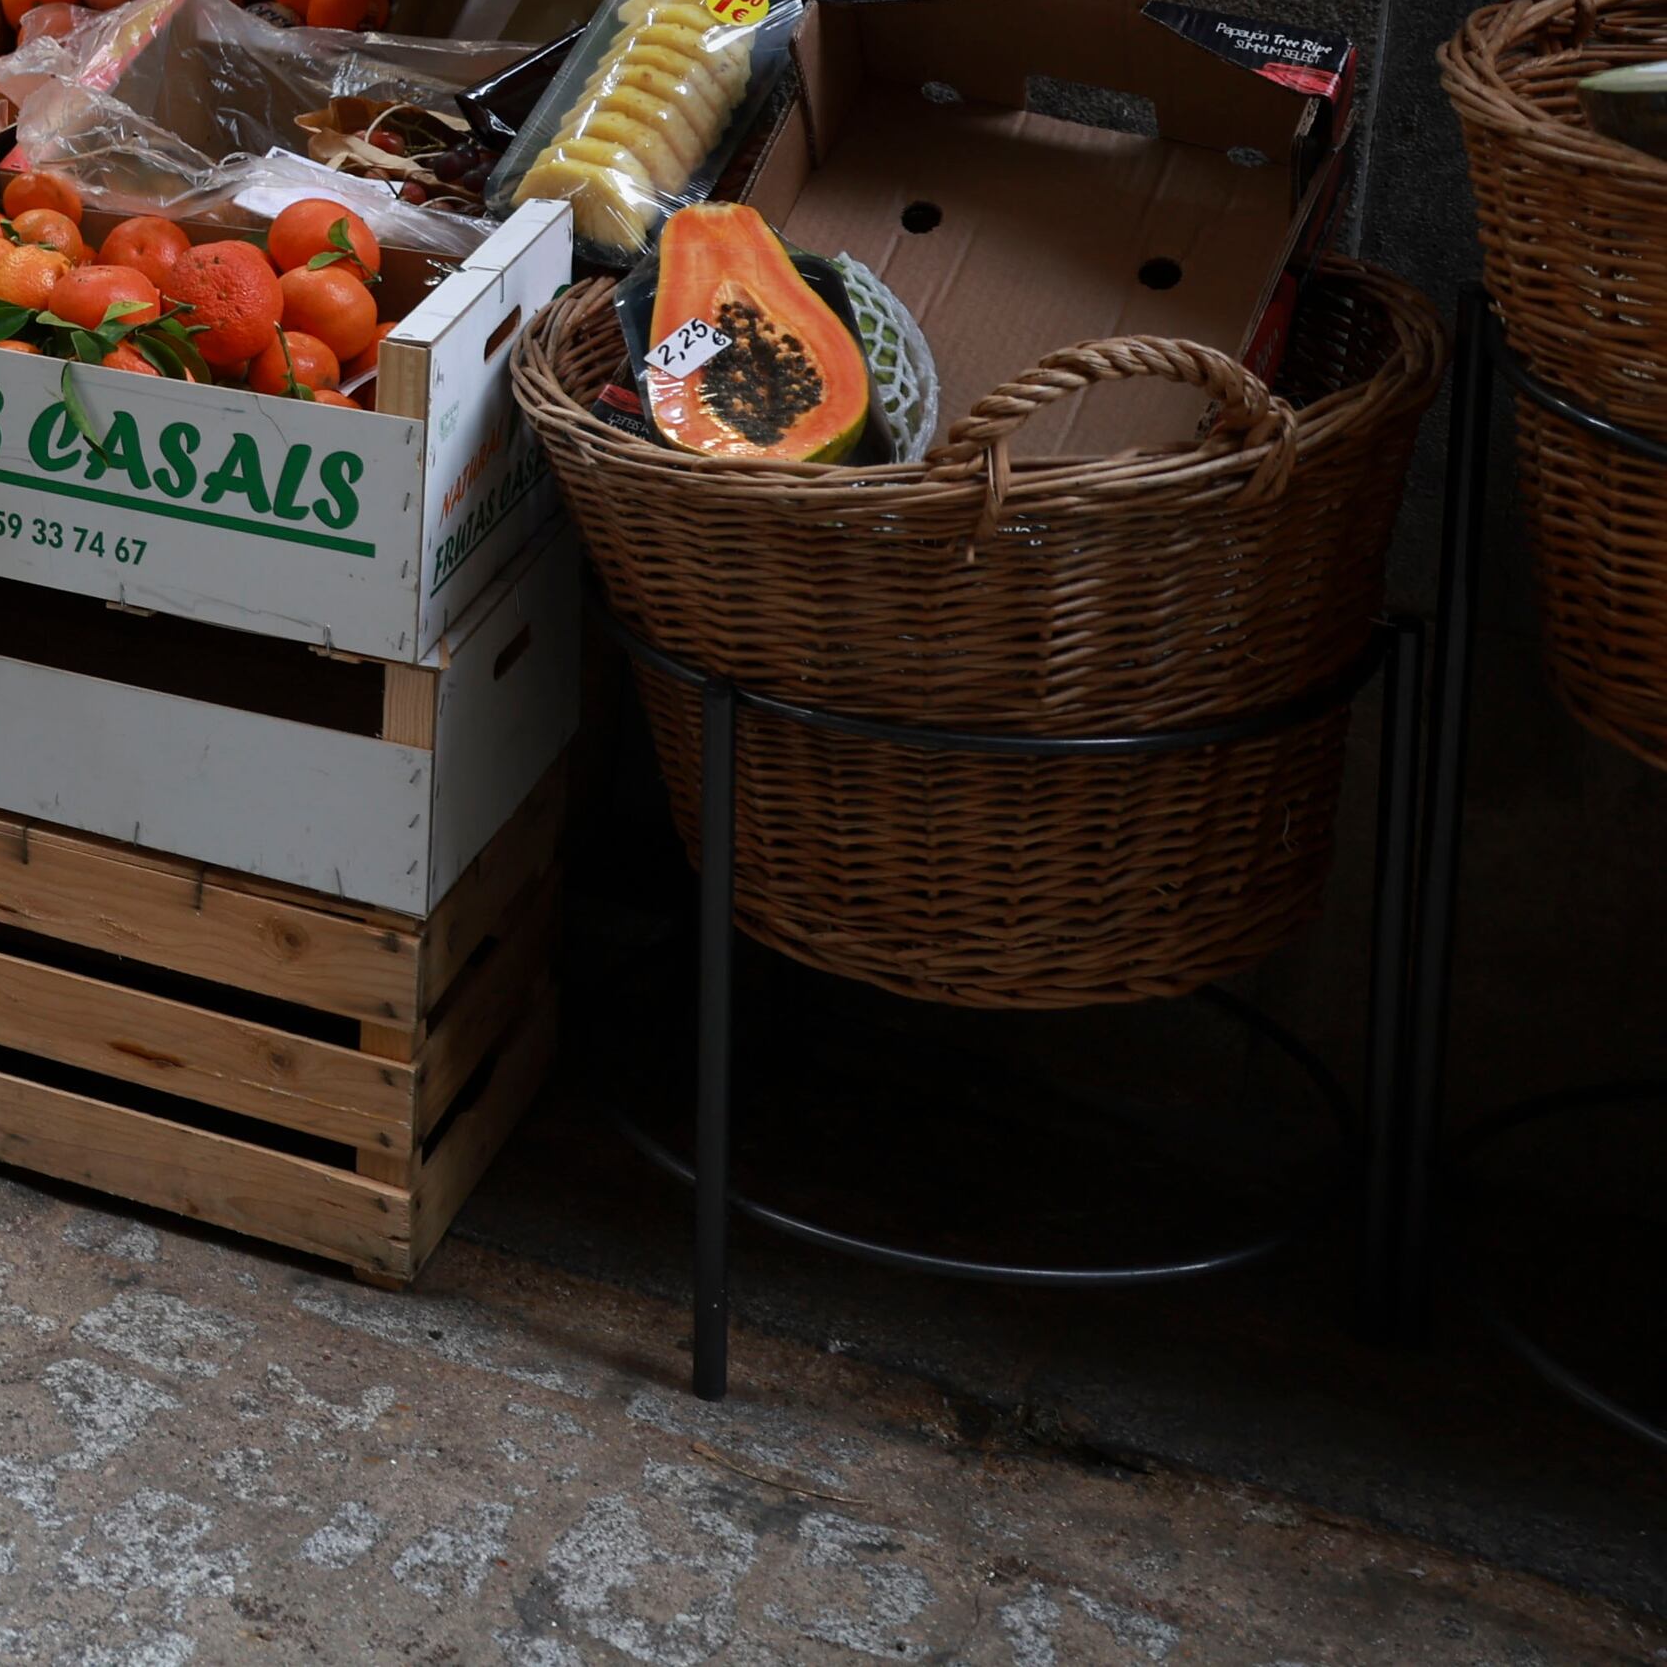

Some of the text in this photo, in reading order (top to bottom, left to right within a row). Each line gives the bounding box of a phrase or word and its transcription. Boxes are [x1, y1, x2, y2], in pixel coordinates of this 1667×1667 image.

[1215, 21, 1333, 56] Papayón Tree Ripe
[1234, 39, 1321, 64] SUMMUM SELECT
[657, 317, 727, 366] 2,25 €
[28, 399, 367, 532] CASALS
[31, 515, 66, 549] 33
[71, 524, 109, 557] 74
[114, 533, 148, 566] 67
[432, 487, 496, 586] FRUTAS
